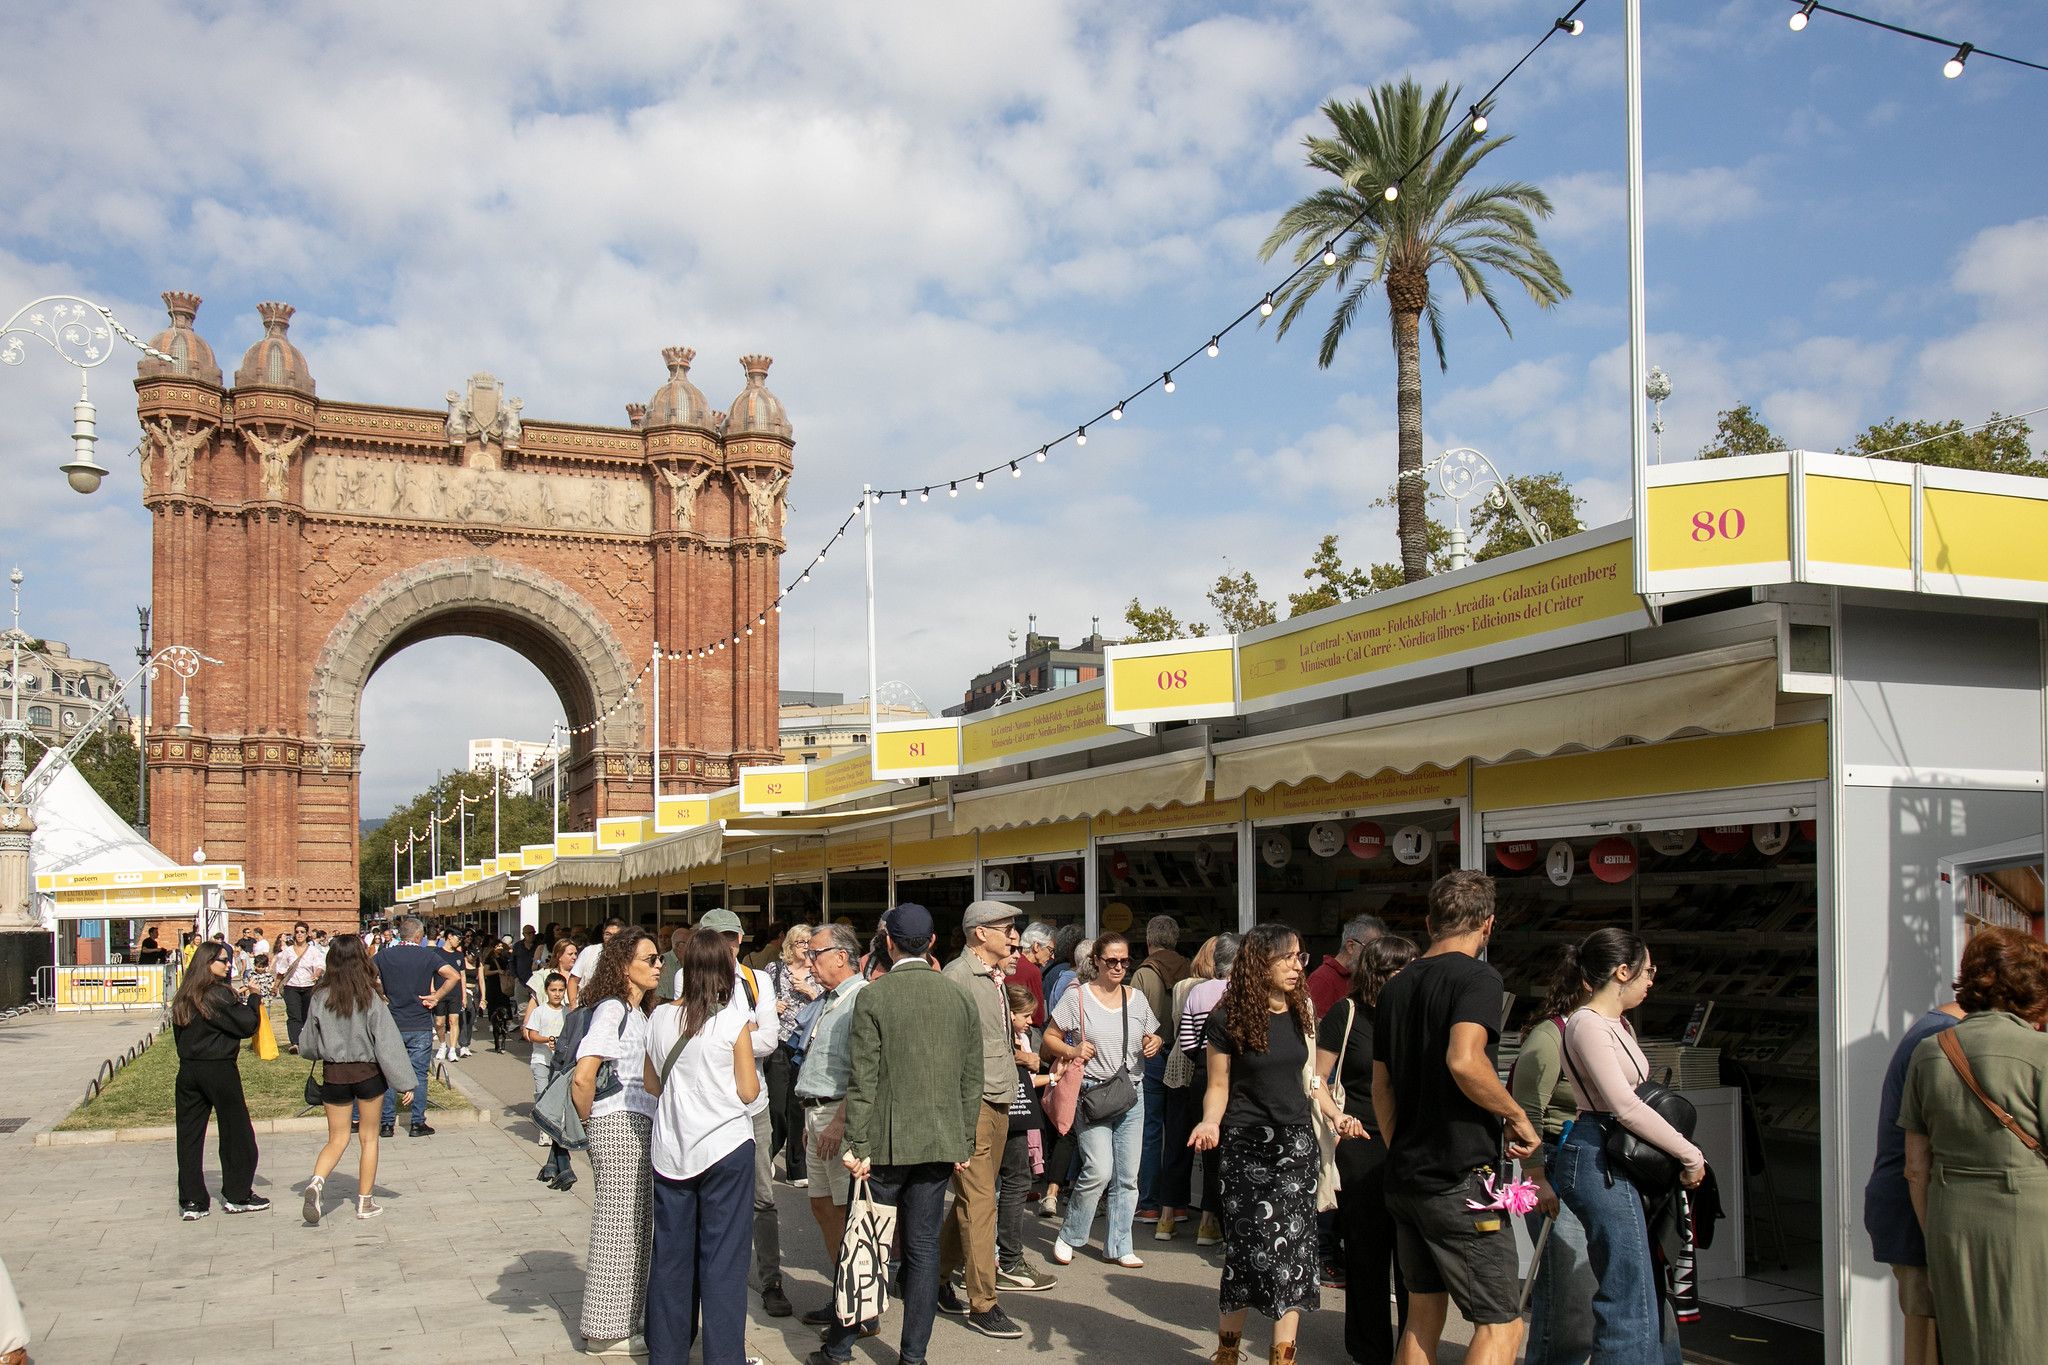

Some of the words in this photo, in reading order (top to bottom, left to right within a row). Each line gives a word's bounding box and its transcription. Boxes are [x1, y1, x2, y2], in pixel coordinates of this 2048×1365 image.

[1690, 508, 1746, 542] 80
[1300, 643, 1310, 657] La
[1310, 634, 1341, 653] Central
[1346, 626, 1381, 644] Navona
[1388, 606, 1447, 634] Folch&Folch
[1453, 592, 1495, 616] Arcàdia
[1502, 580, 1548, 603] Galaxia
[1551, 562, 1617, 591] Gutenberg
[1300, 652, 1341, 674] Minúscula
[1346, 645, 1362, 662] Cal
[1363, 639, 1392, 658] Carré
[1437, 624, 1466, 641] libres
[1472, 611, 1521, 632] Edicions
[1523, 603, 1542, 620] del
[1544, 594, 1584, 615] Cràter
[1157, 669, 1188, 691] 08
[909, 742, 926, 758] 81
[767, 783, 782, 795] 82
[677, 809, 690, 819] 83
[615, 829, 626, 838] 84
[1715, 825, 1745, 834] CENTRAL
[1359, 835, 1380, 844] CENTRAL
[1508, 843, 1534, 854] CENTRAL
[1604, 855, 1632, 865] CENTRAL
[73, 875, 98, 883] parlem
[164, 871, 188, 879] parlem
